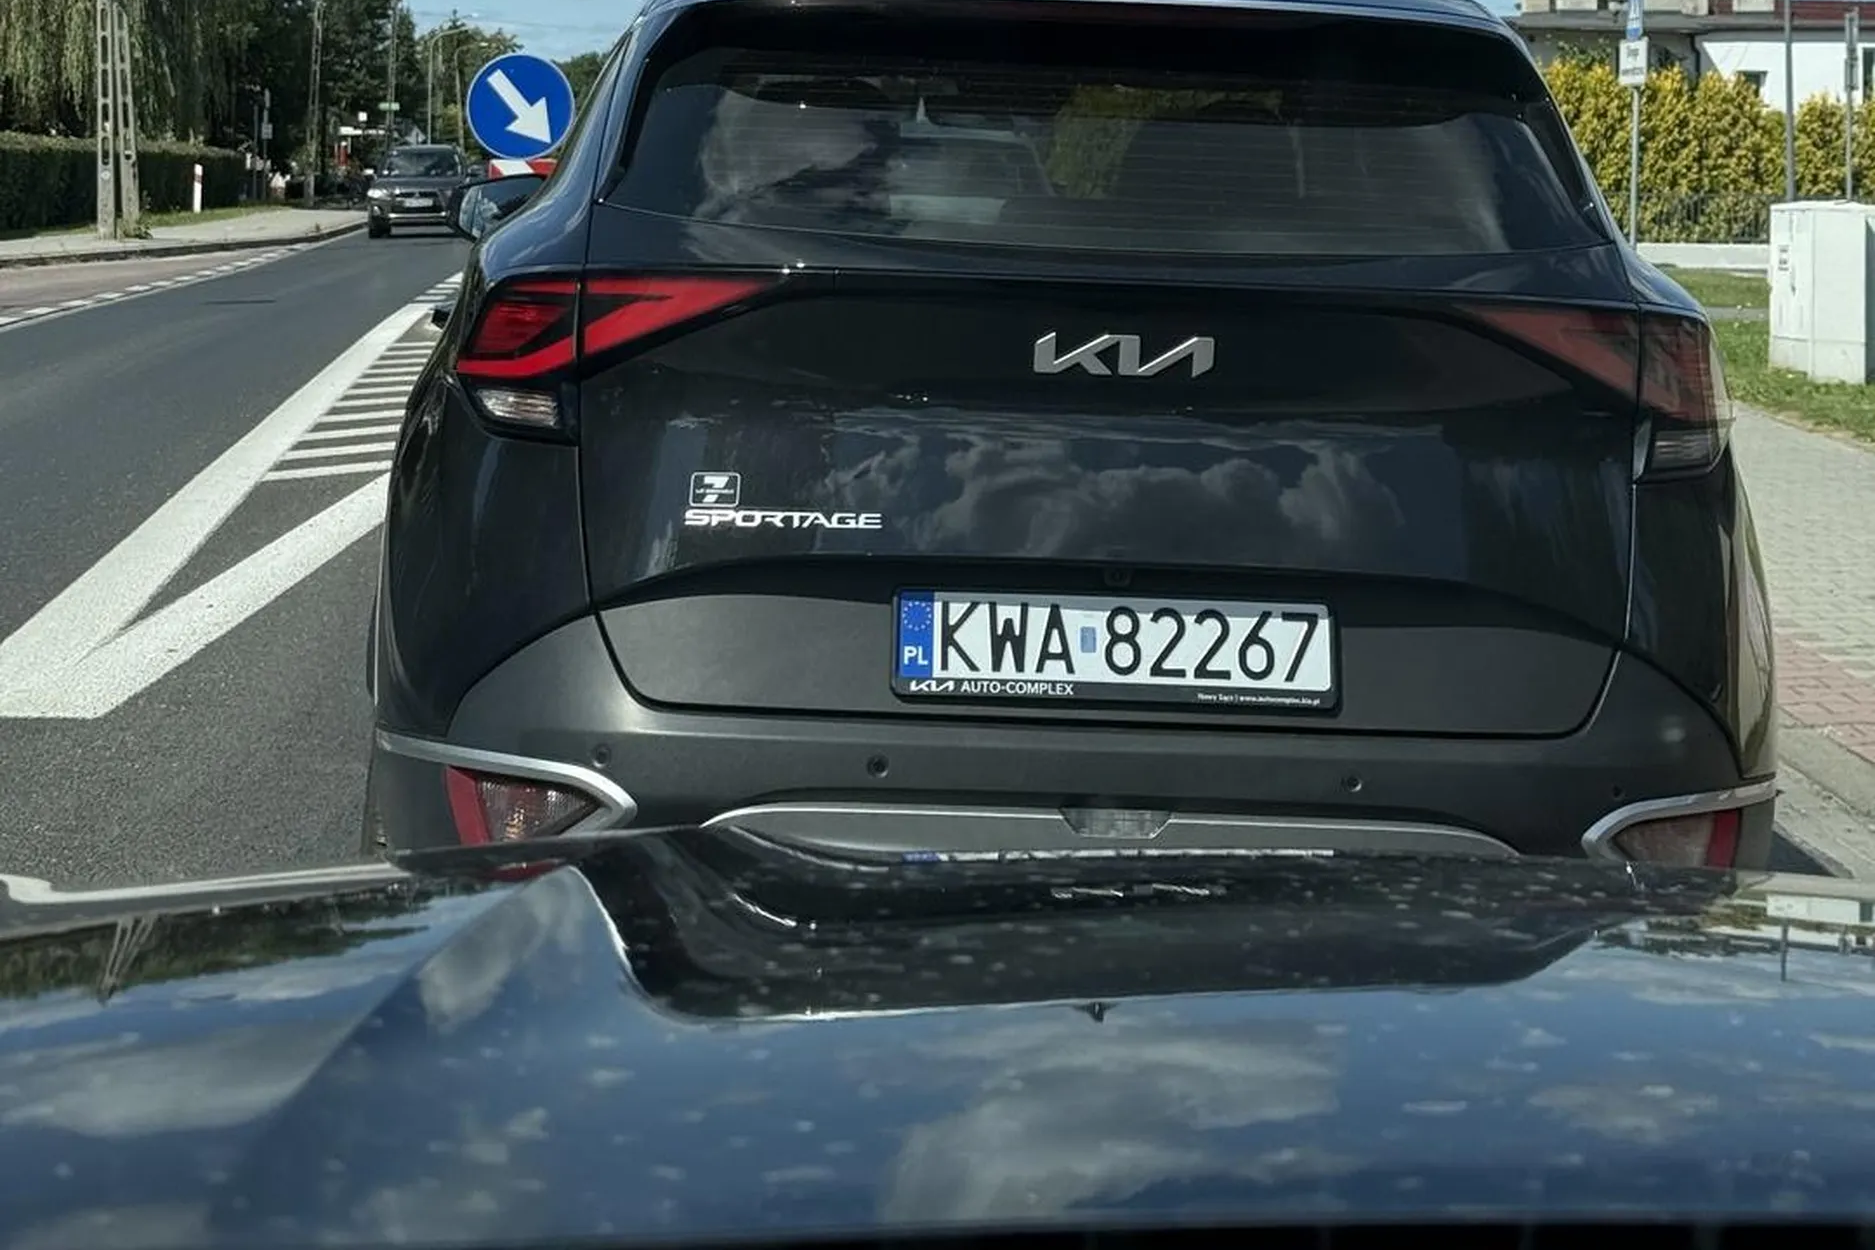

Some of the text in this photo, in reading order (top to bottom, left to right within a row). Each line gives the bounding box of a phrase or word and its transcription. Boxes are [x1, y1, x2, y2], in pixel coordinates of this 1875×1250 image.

[1033, 331, 1215, 378] KIA
[684, 508, 883, 529] SPORTAGE
[940, 600, 1319, 683] KWA 82267
[903, 646, 929, 665] PL
[909, 679, 1075, 696] KIA AUTO-COMPLEX
